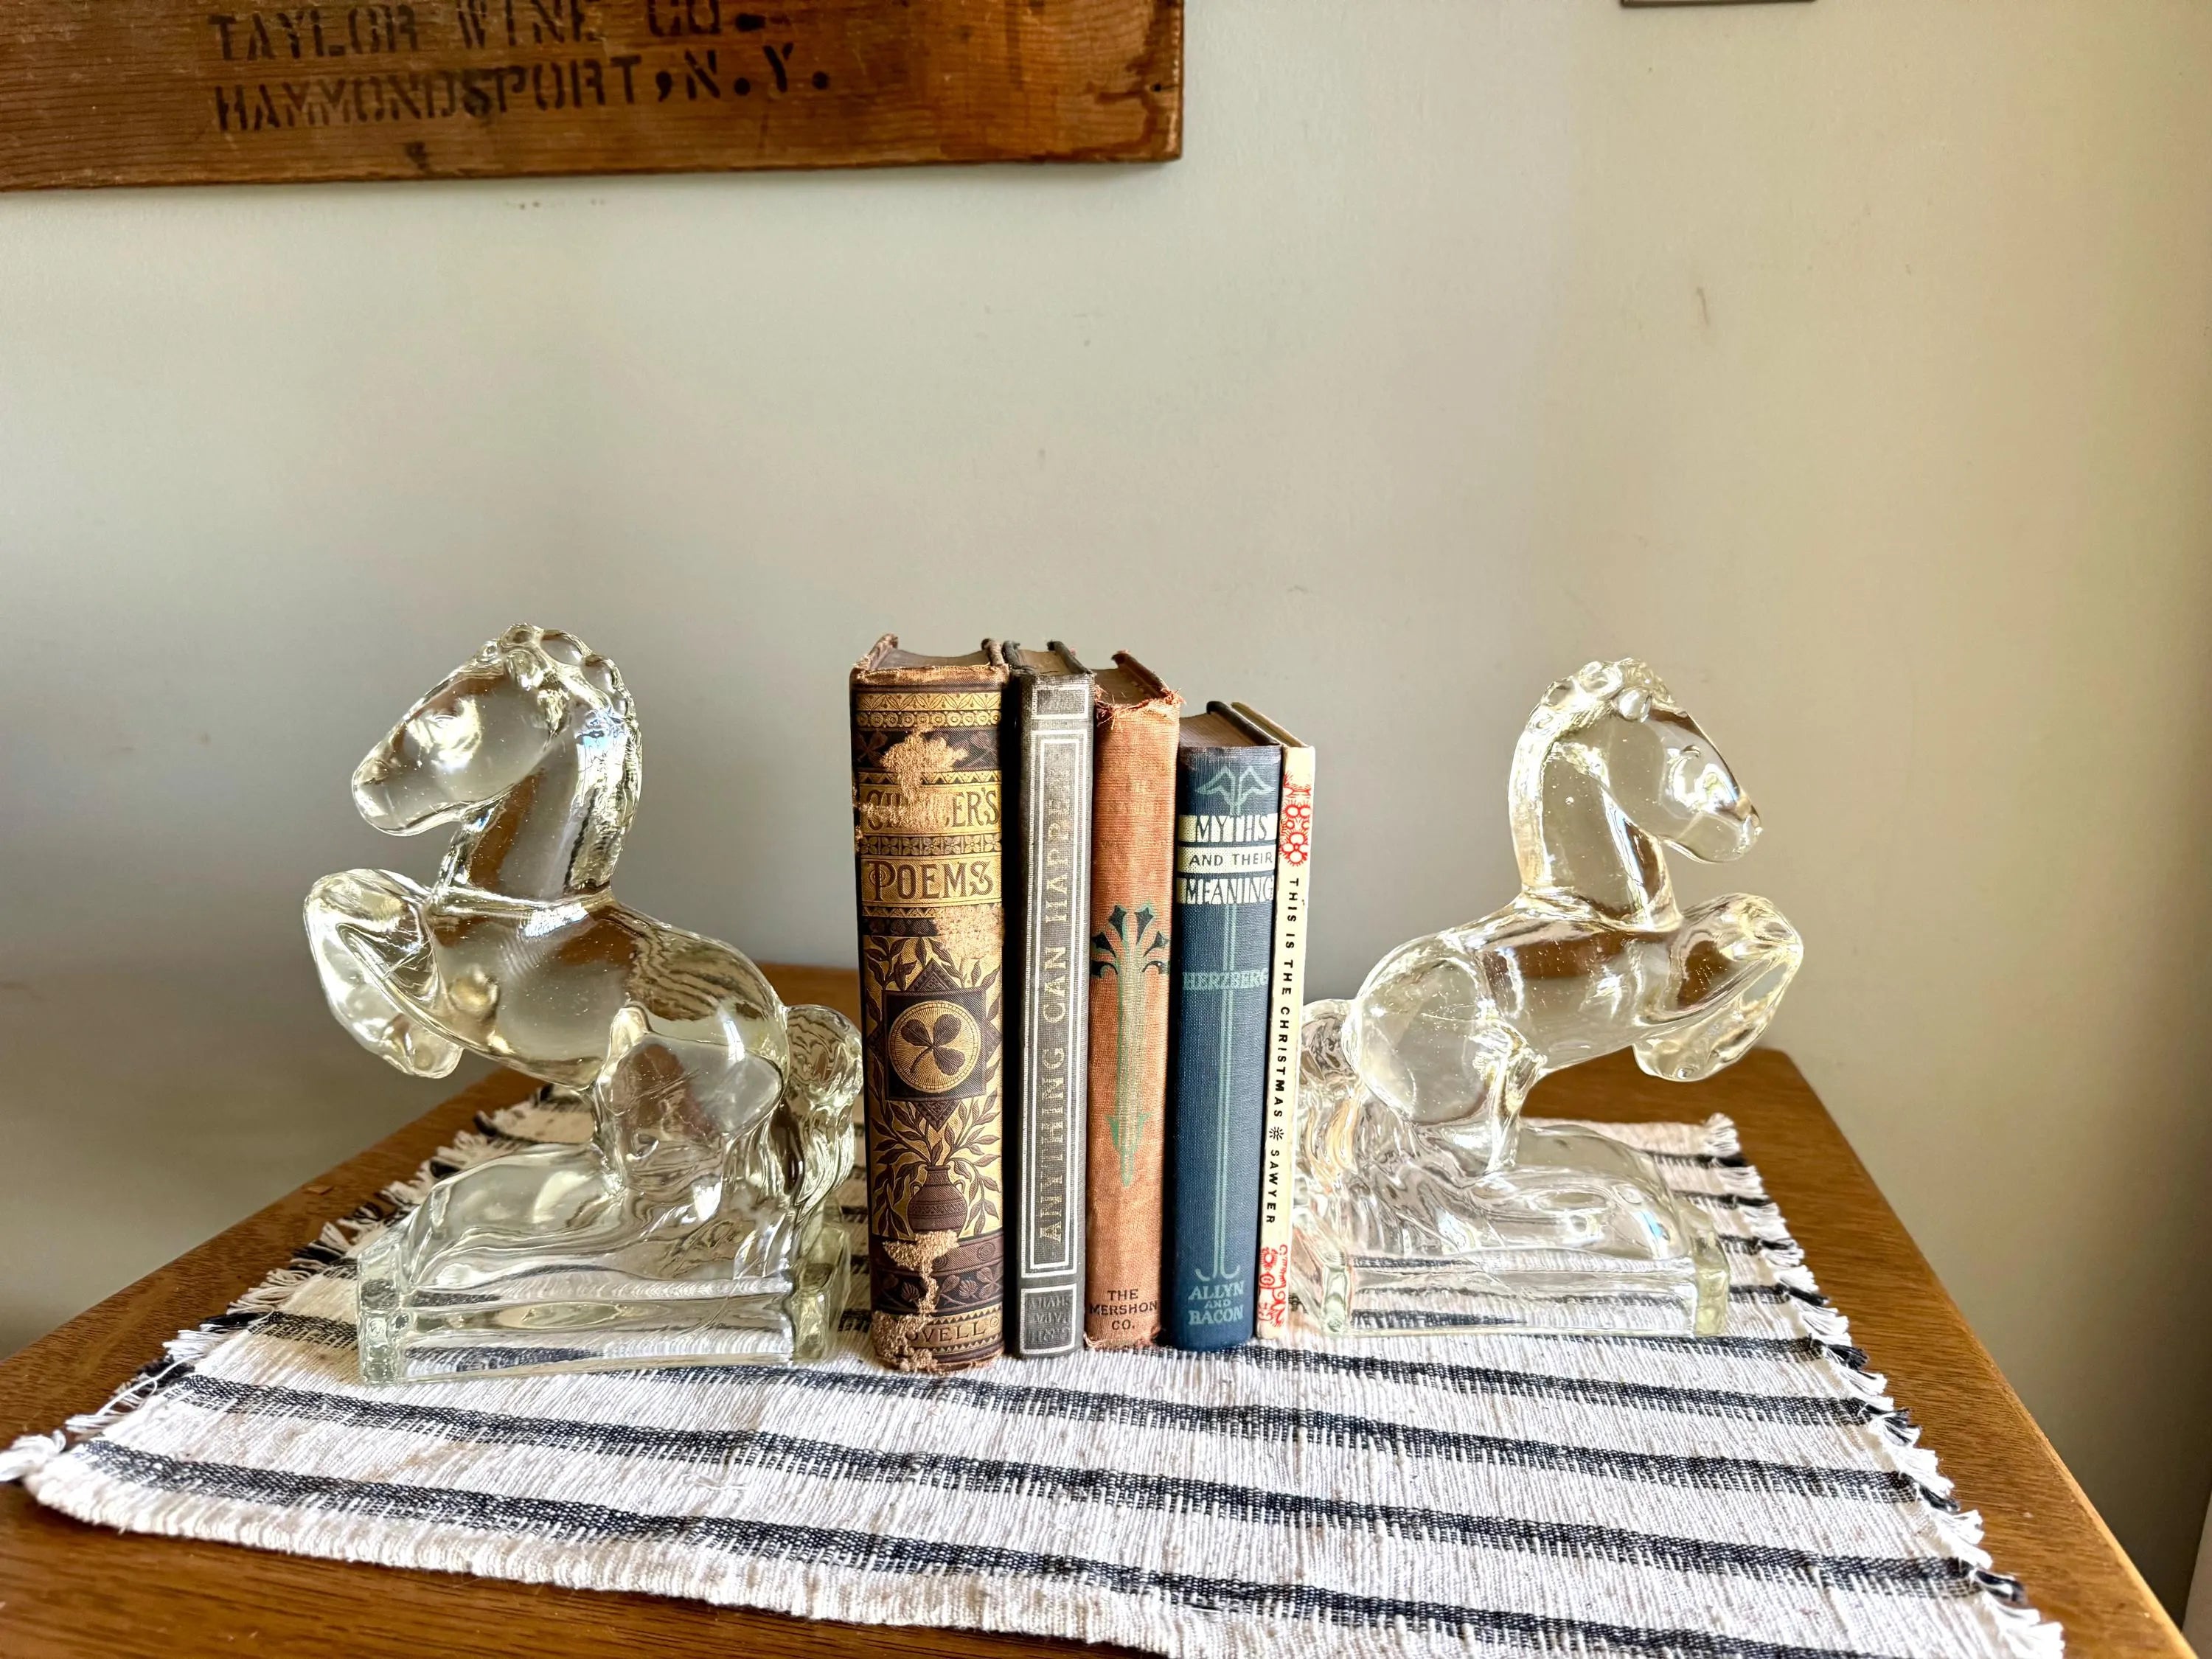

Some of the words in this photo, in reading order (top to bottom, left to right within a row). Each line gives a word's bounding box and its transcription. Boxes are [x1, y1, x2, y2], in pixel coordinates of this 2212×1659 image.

[208, 4, 418, 60] TAYLOR
[456, 0, 597, 49] WINE
[1195, 814, 1268, 842] MYTHS
[1189, 854, 1223, 866] AND
[1231, 852, 1273, 866] THEIR
[866, 860, 994, 902] POEMS
[1186, 876, 1273, 905] MEANING
[1287, 877, 1299, 922] THIS
[1285, 933, 1295, 949] IS
[1043, 946, 1066, 1023] CAN
[1281, 959, 1293, 995] THE
[1273, 1006, 1290, 1118] CHRISTMAS
[1040, 1047, 1065, 1243] ANYTHING
[1266, 1150, 1280, 1224] SAWYER
[1107, 1289, 1139, 1301] THE
[1187, 1281, 1245, 1301] ALLYN
[1204, 1300, 1231, 1310] AND
[1089, 1300, 1158, 1316] MERSHON
[1188, 1305, 1244, 1325] BACON
[1111, 1319, 1135, 1331] CO.
